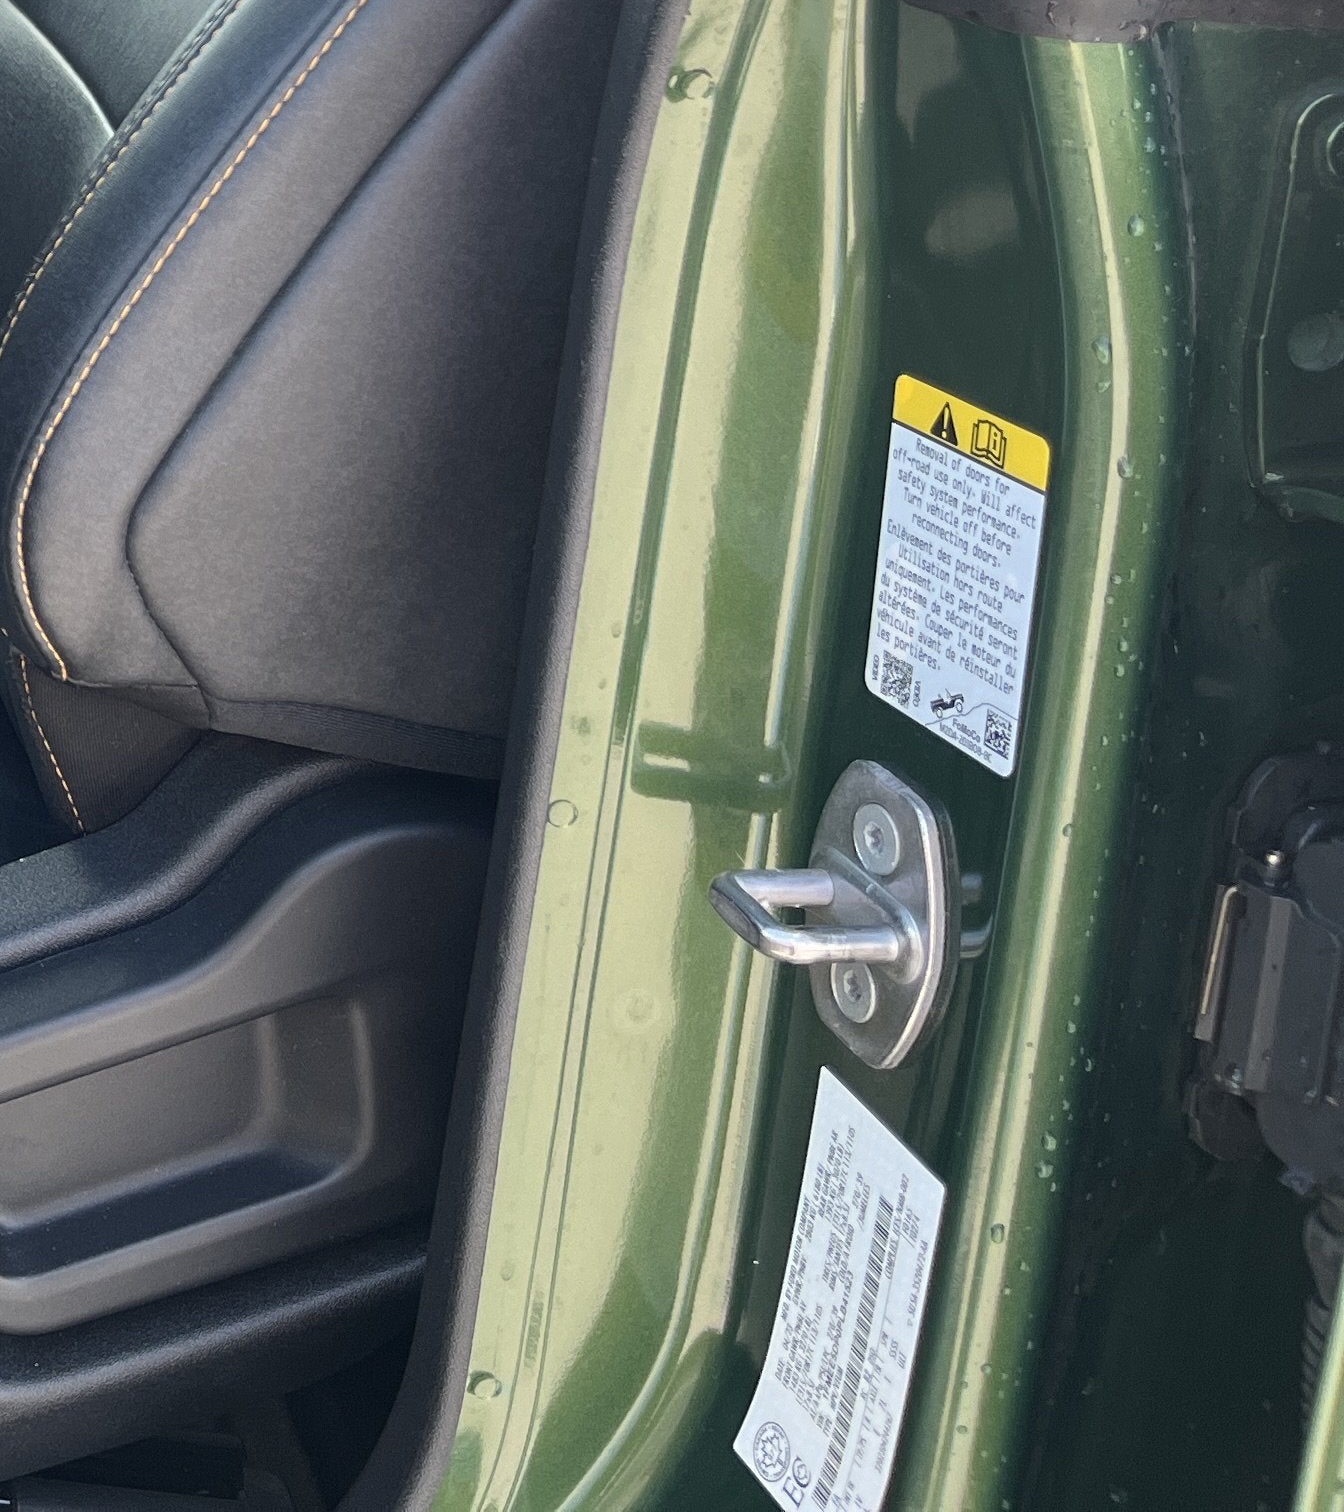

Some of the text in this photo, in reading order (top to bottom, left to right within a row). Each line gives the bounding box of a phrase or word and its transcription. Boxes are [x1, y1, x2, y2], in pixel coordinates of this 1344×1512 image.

[892, 448, 1035, 529] off-road use only. Will affect
[915, 438, 1009, 495] Removal of doors for
[897, 469, 1019, 538] safety system performance.
[903, 486, 1011, 555] Turn vehicle off before
[887, 518, 1024, 603] Enlèvement des portières pour
[911, 513, 1000, 567] reconnecting doors.
[885, 559, 1017, 640] uniquement. Les performances
[898, 544, 1002, 613] Utilisation hors route
[876, 622, 890, 642] les
[880, 571, 1017, 660] du système de sécurité seront
[924, 613, 953, 639] Couper
[957, 631, 967, 650] le
[971, 644, 1000, 667] moteur
[1004, 662, 1016, 678] du
[876, 608, 1013, 694] véhicule avant de réinstaller
